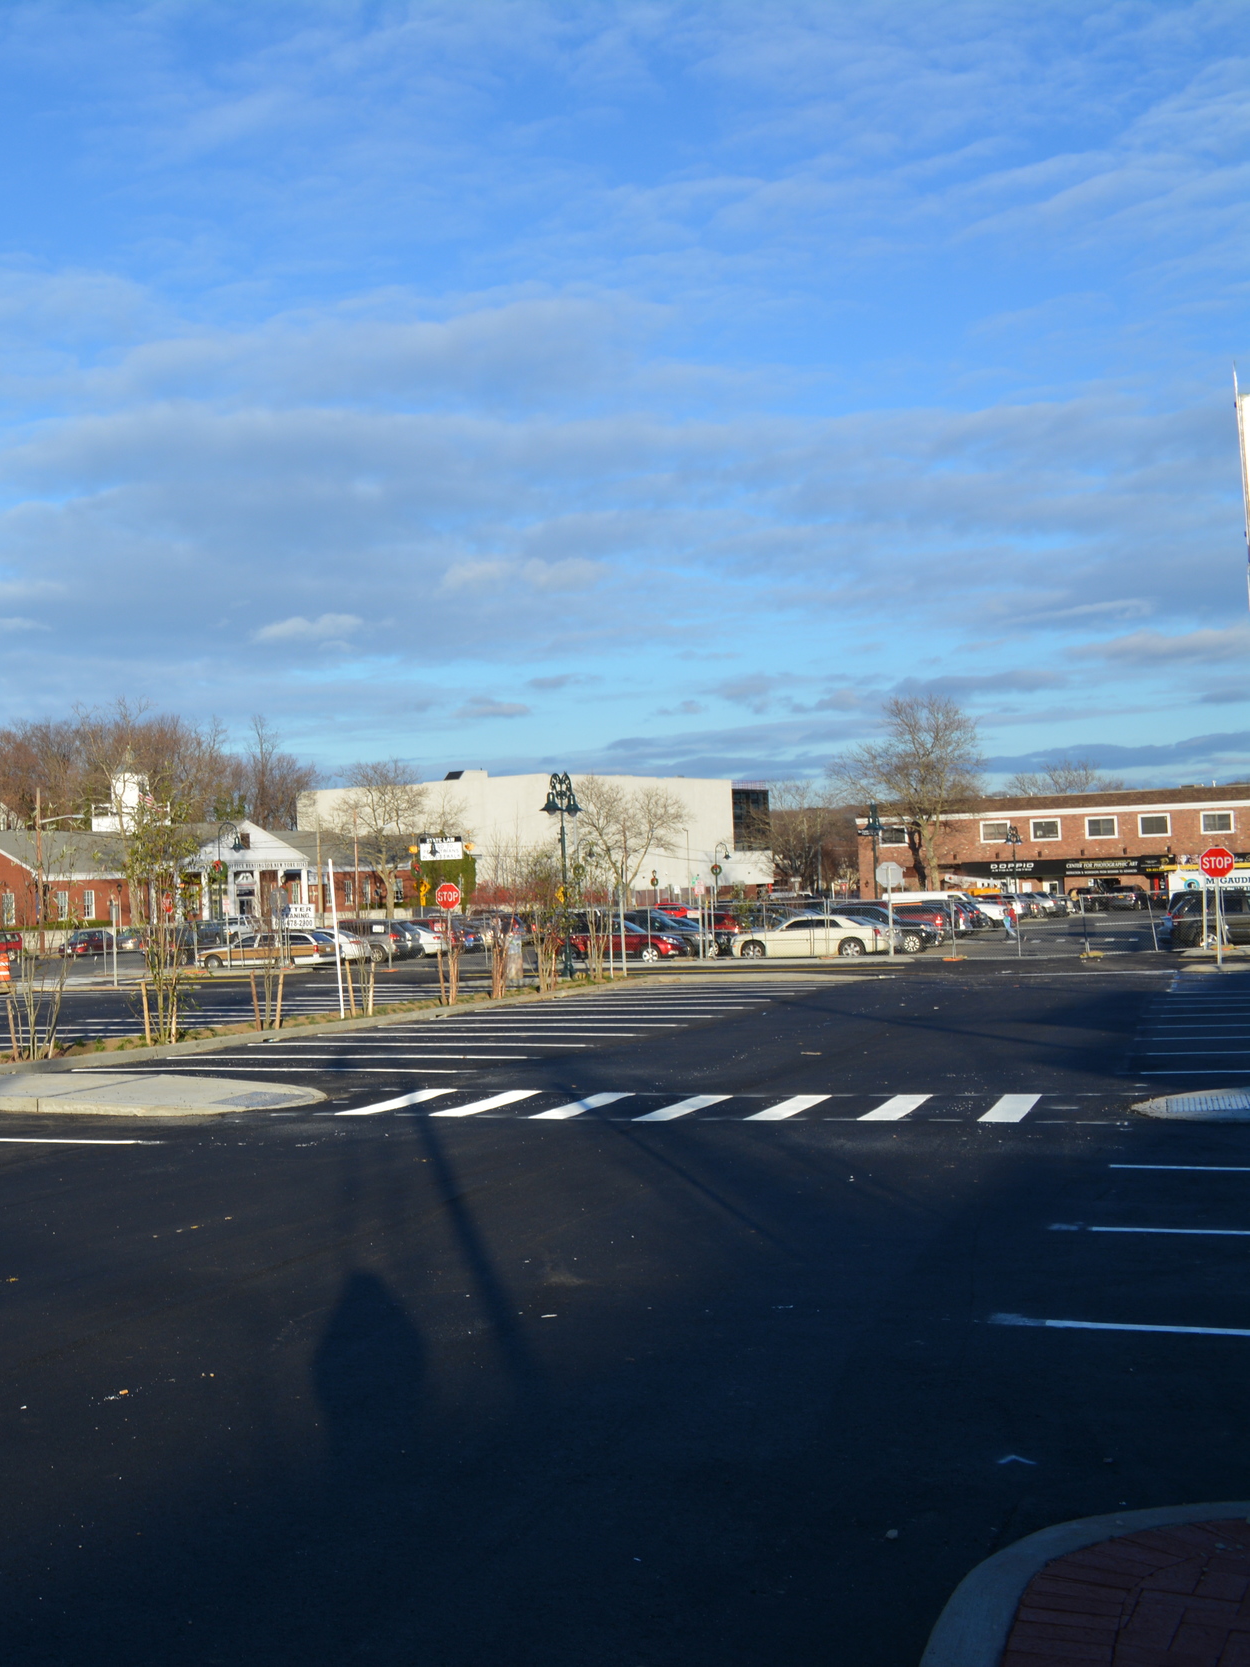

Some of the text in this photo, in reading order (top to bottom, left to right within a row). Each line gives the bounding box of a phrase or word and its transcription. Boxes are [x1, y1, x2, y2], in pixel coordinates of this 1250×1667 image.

[990, 862, 1035, 870] DOPPIO
[1202, 856, 1232, 869] STOP
[437, 891, 459, 902] STOP
